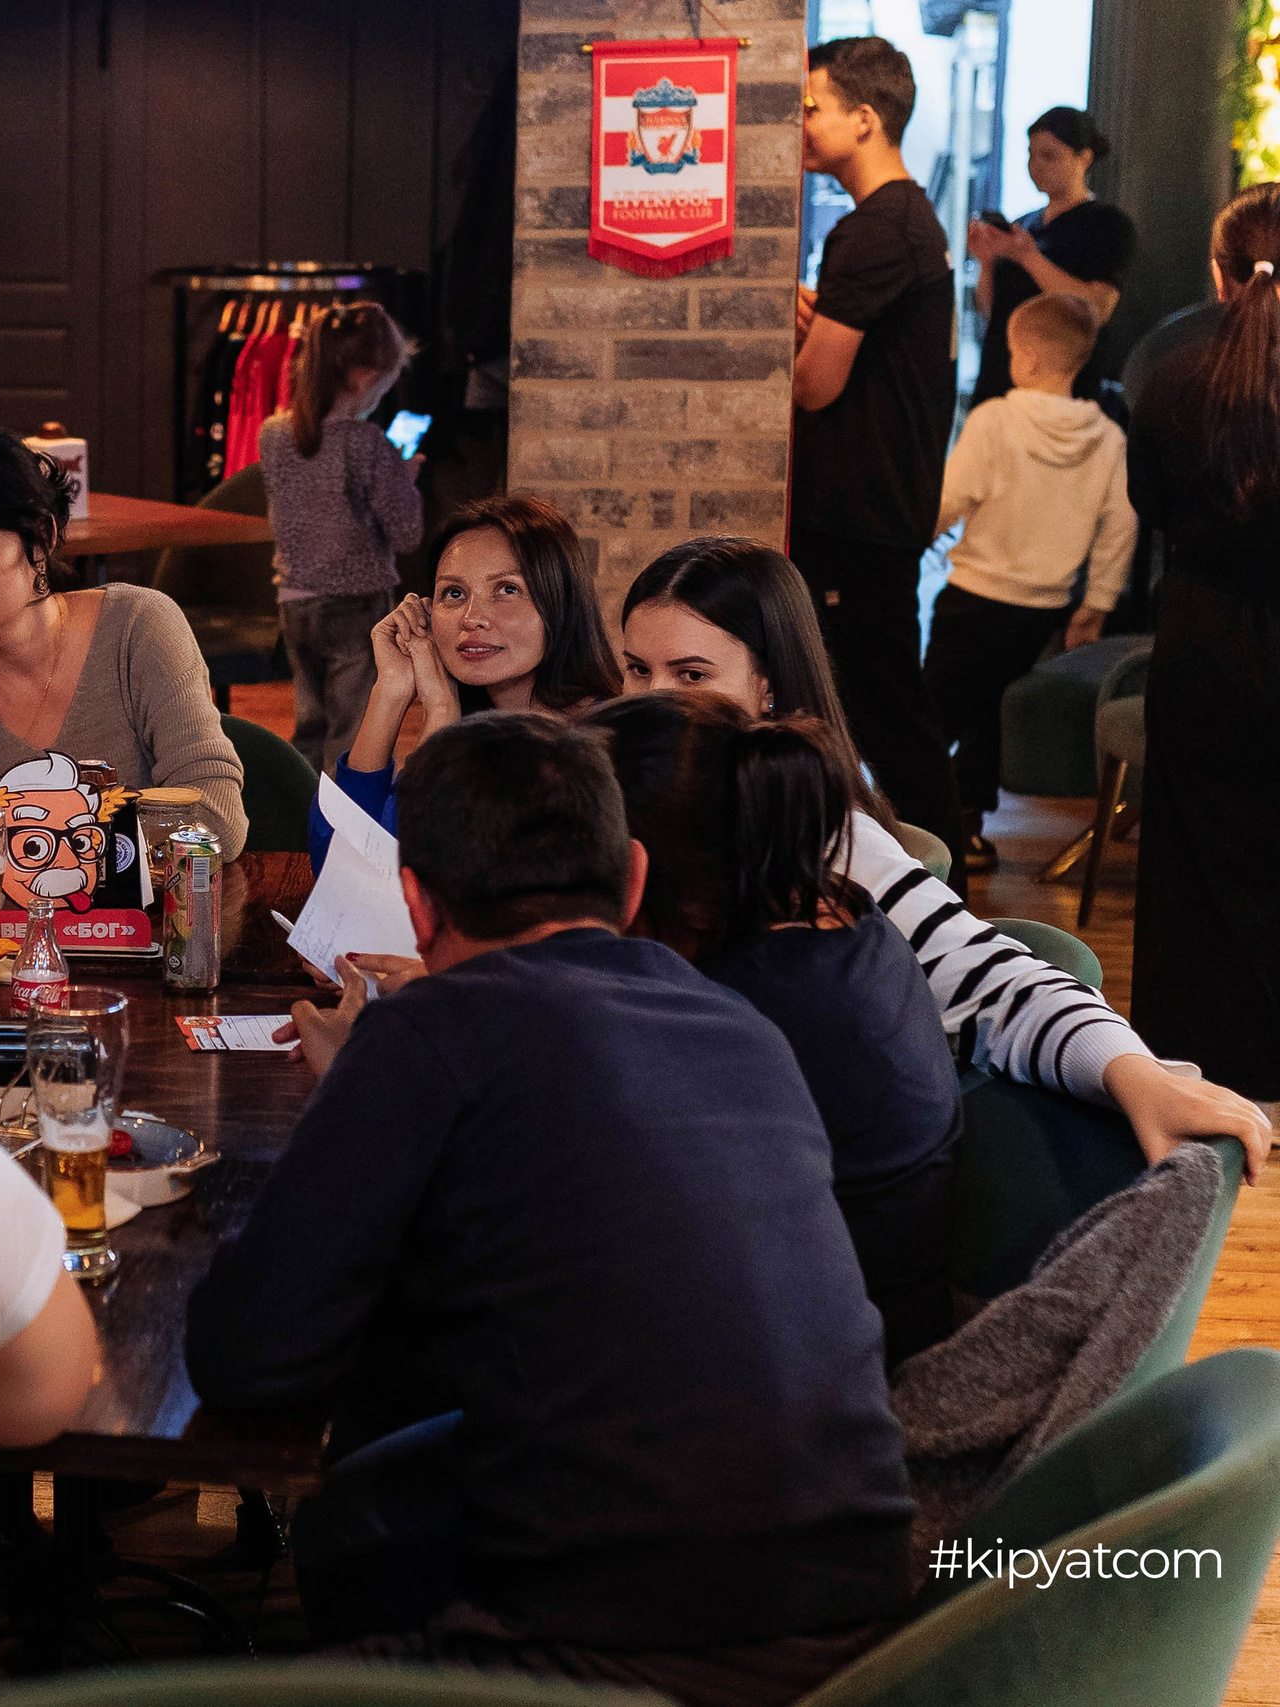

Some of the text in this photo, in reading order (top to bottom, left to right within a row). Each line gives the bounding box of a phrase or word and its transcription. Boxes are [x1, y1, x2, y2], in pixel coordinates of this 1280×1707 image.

[613, 207, 713, 219] FOOTBALL CLUB
[62, 922, 136, 938] «БОГ»
